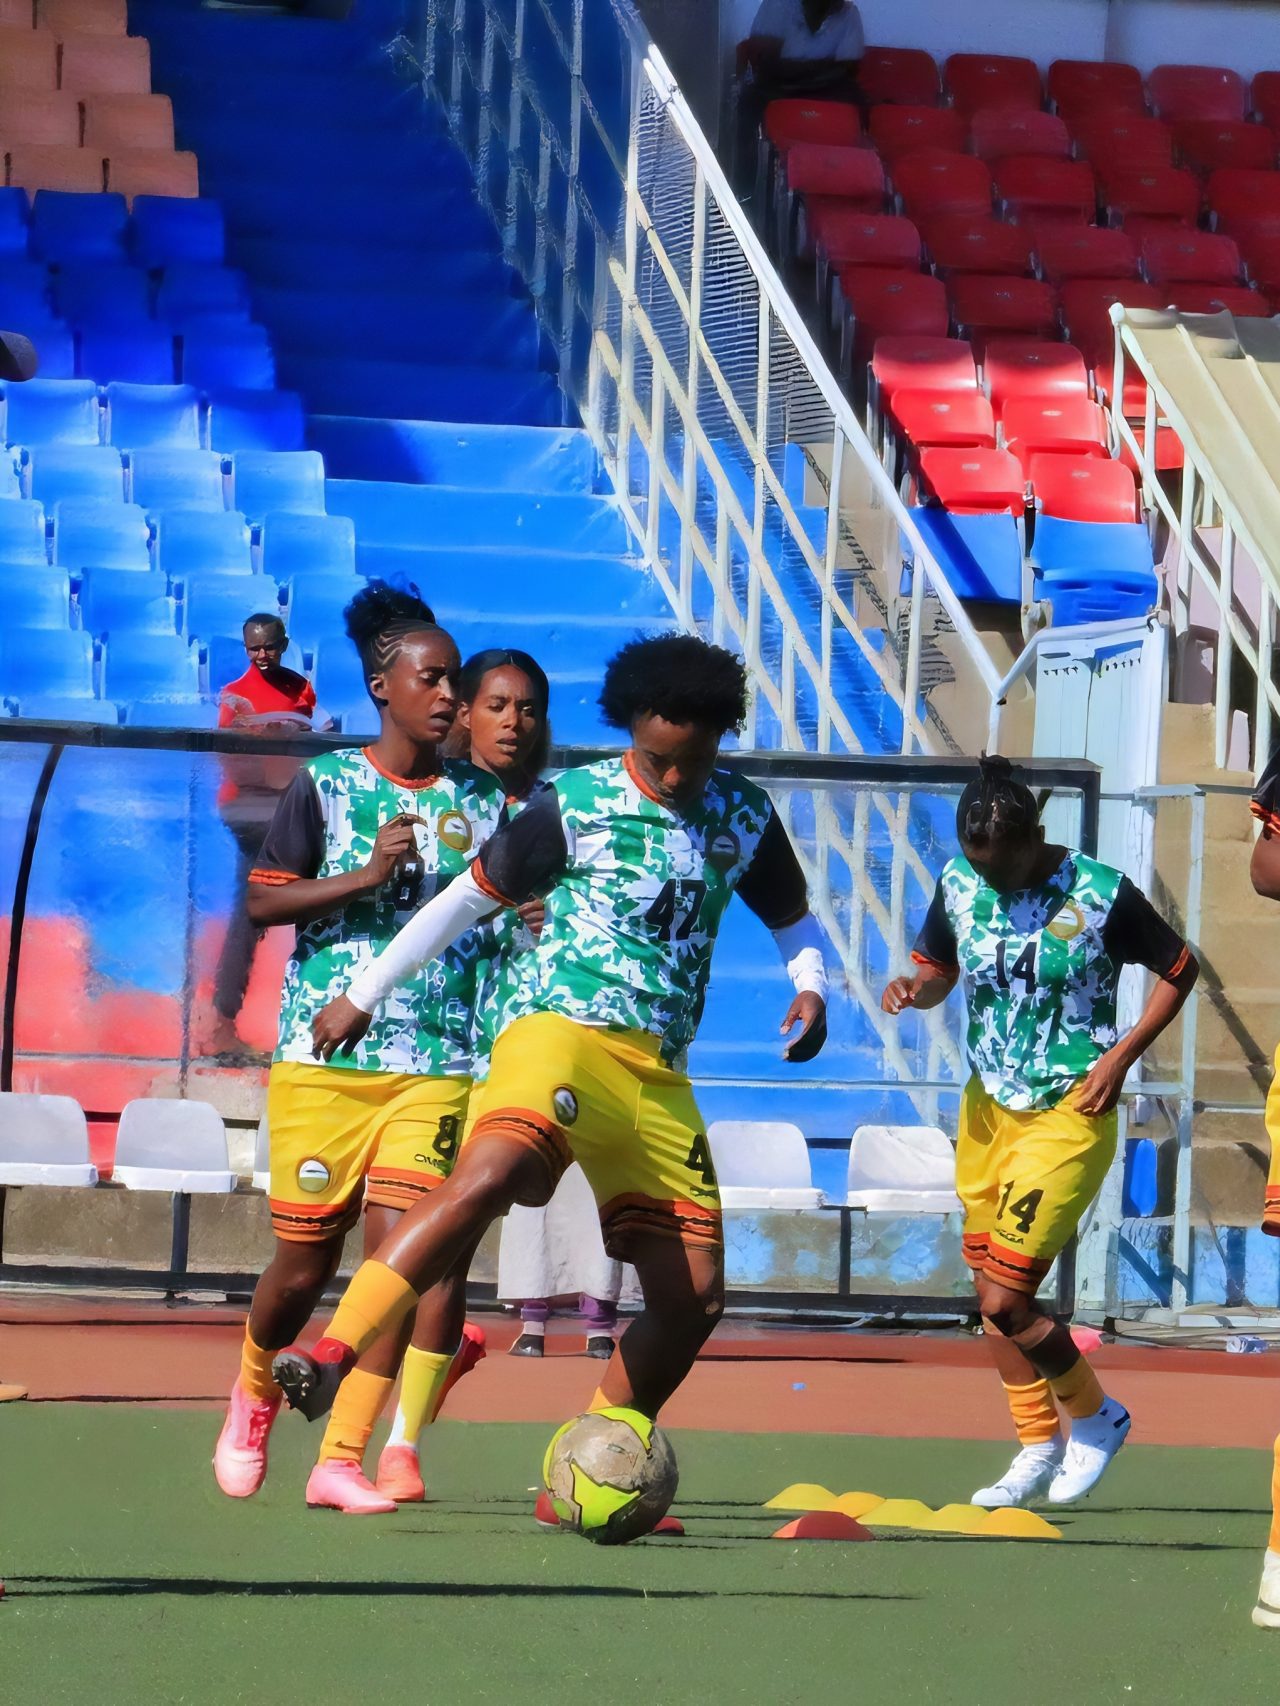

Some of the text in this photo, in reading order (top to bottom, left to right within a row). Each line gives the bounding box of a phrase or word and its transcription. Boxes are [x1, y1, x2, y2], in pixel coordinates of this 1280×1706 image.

[644, 878, 708, 941] 47
[995, 939, 1037, 995] 14
[432, 1114, 458, 1161] 8
[996, 1180, 1044, 1234] 14
